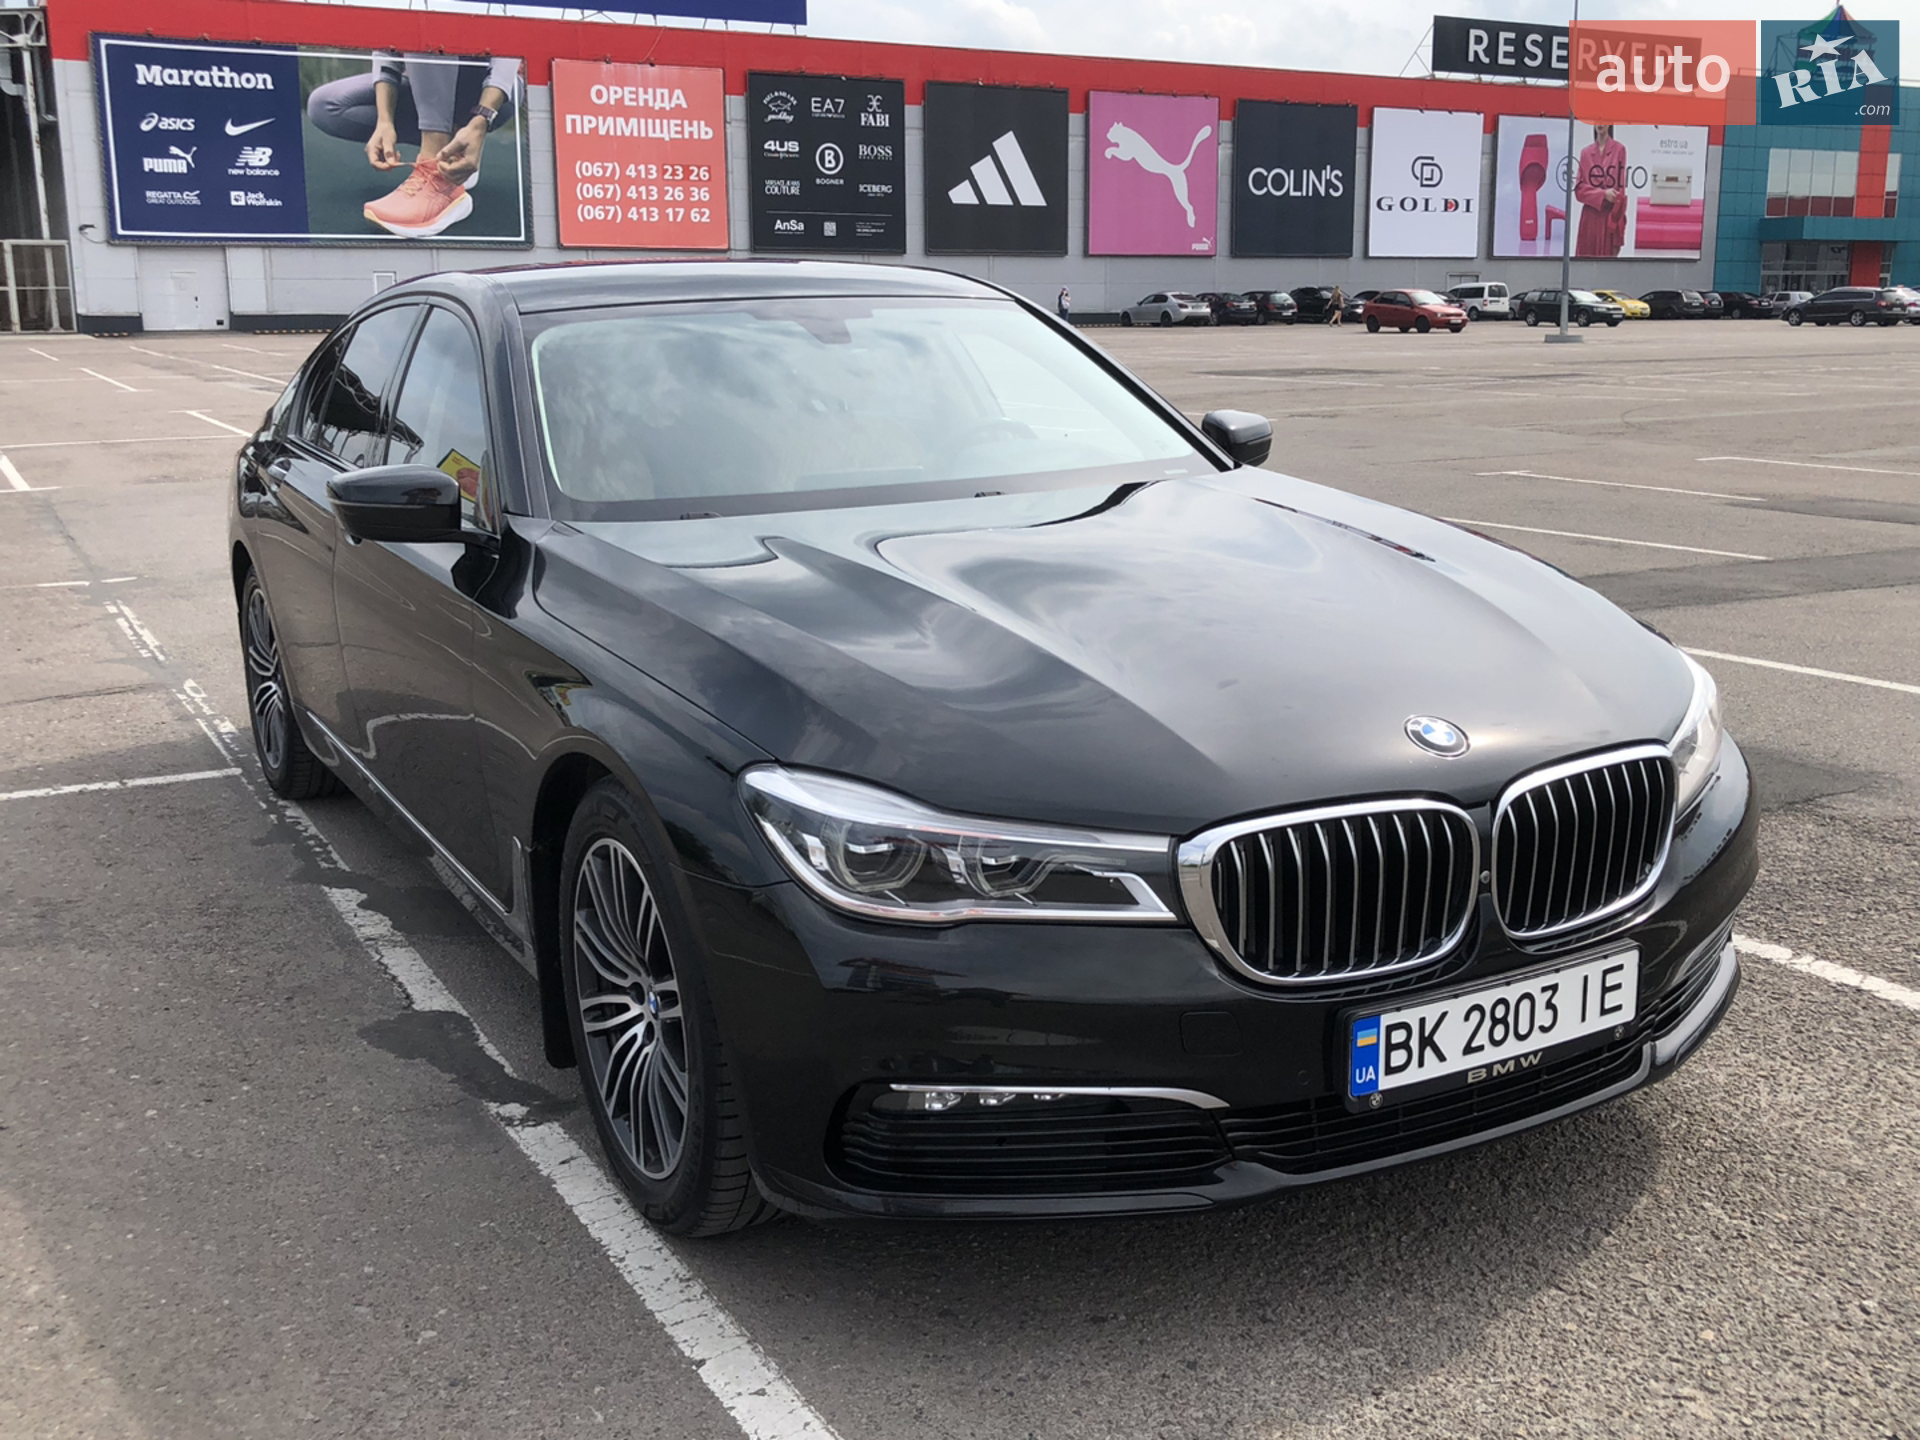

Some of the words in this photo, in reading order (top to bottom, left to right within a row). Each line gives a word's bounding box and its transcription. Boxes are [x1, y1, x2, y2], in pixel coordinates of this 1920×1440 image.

[135, 64, 274, 90] Marathon
[590, 84, 688, 110] ОРЕНДА
[811, 97, 845, 113] EA7
[565, 114, 713, 141] ПРИМІЩЕНЬ
[860, 112, 890, 127] FABI
[764, 140, 799, 152] 4US
[859, 144, 893, 157] BOSS
[143, 157, 187, 173] PUMA
[575, 160, 620, 180] (067)
[625, 164, 657, 179] 413
[663, 165, 683, 180] 23
[689, 166, 710, 181] 26
[1248, 165, 1343, 197] COLIN'S
[1589, 161, 1648, 189] estro
[145, 190, 182, 198] REGATTA
[576, 182, 621, 202] (067)
[626, 185, 658, 200] 413
[664, 186, 684, 201] 26
[689, 187, 710, 201] 36
[765, 186, 800, 195] COUTURE
[859, 184, 892, 193] ICEBERG
[577, 204, 622, 223] (067)
[627, 207, 659, 221] 413
[665, 208, 685, 222] 17
[690, 208, 710, 222] 62
[1376, 196, 1473, 213] GOLDI
[774, 219, 804, 230] AnSa
[1384, 1010, 1449, 1076] BK
[1462, 982, 1559, 1056] 2803
[1581, 963, 1624, 1024] IE
[1355, 1065, 1376, 1084] UA
[1467, 1051, 1543, 1084] BMW
